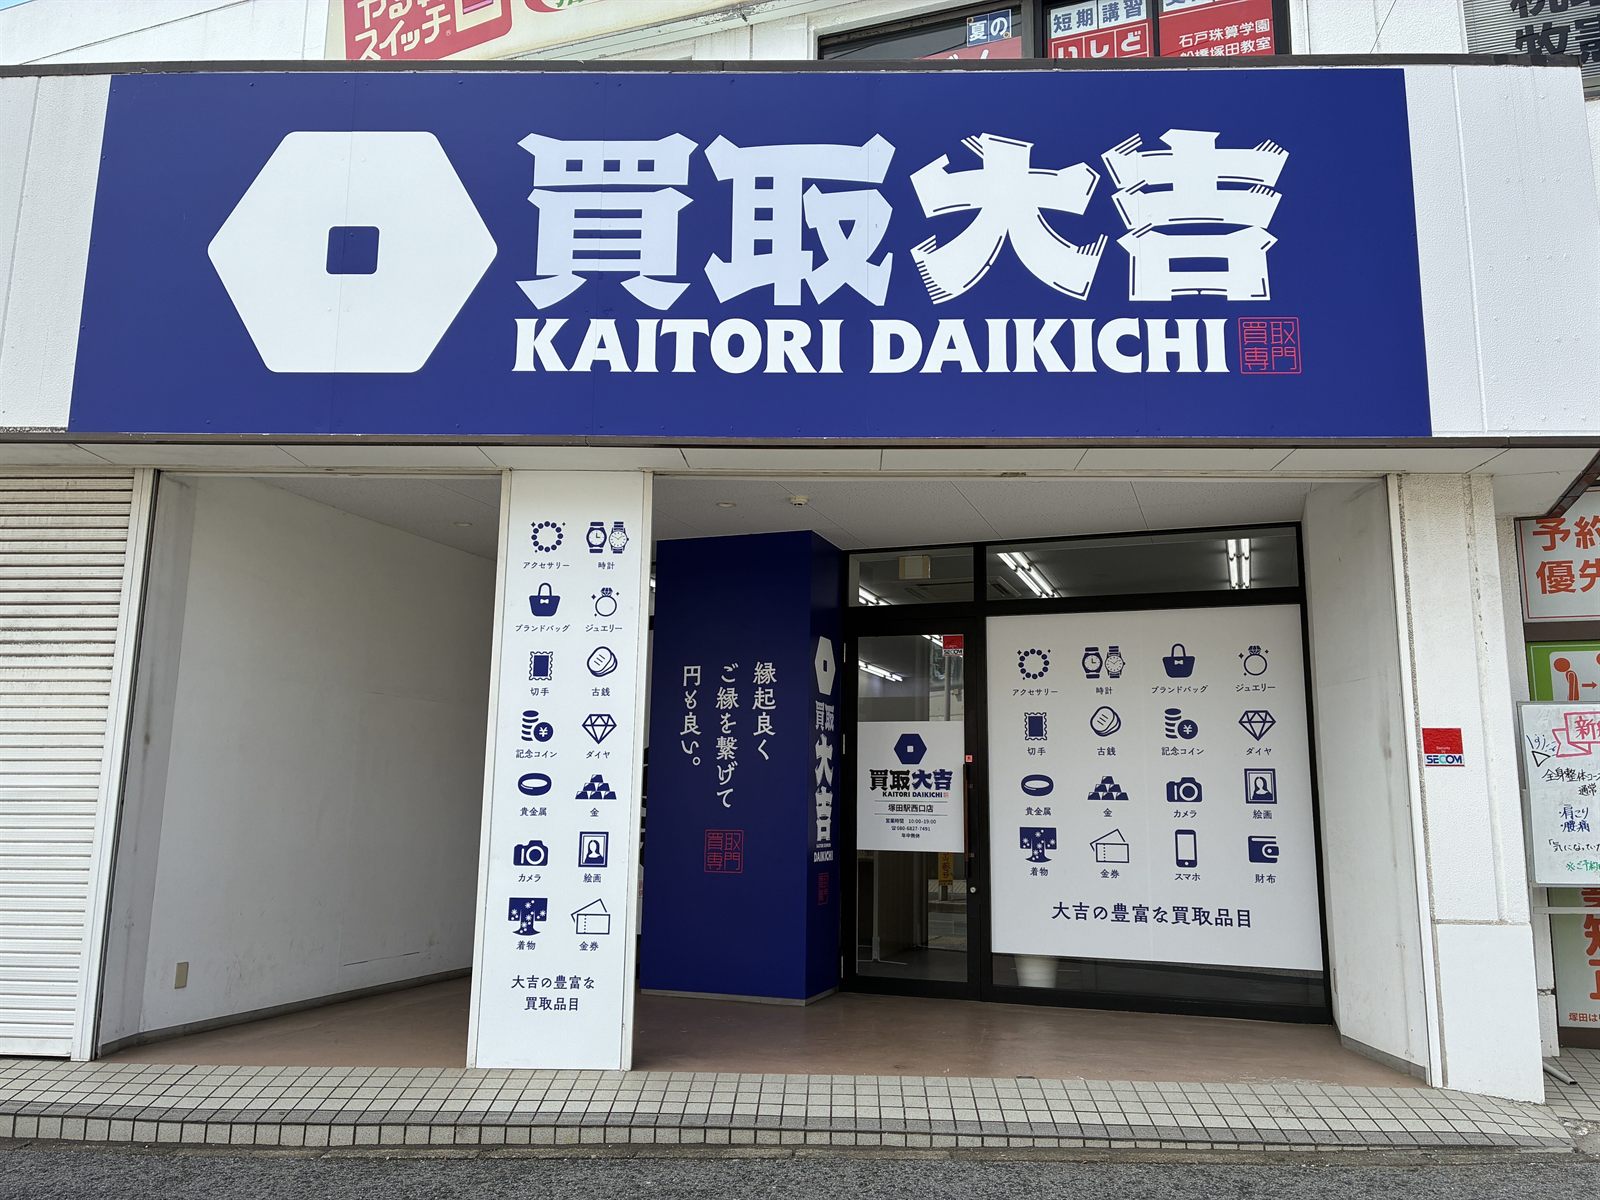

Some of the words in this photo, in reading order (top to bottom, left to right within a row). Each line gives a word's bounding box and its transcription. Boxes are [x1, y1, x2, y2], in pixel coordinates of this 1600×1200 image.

[357, 0, 442, 29] やる
[1053, 0, 1142, 33] 短期講習
[355, 4, 450, 59] スイッチ
[969, 17, 1008, 41] 夏の
[1178, 18, 1270, 48] 石戸珠算学園
[1057, 30, 1141, 58] いしど
[516, 129, 1289, 310] 買取大吉
[512, 319, 843, 373] KAITORI
[870, 318, 1230, 373] DAIKICHI
[522, 561, 571, 570] アクセサリー
[597, 560, 616, 571] 時計
[514, 623, 571, 633] ブランドバッグ
[584, 623, 623, 633] ジュエリー
[529, 686, 550, 697] 切手
[591, 686, 611, 697] 古銭
[1012, 687, 1059, 697] アクセサリー
[1095, 685, 1113, 696] 時計
[1151, 684, 1209, 696] ブランドバッグ
[1235, 682, 1277, 694] ジュエリー
[679, 665, 702, 767] 円も良い。
[752, 661, 778, 762] 縁起良く
[715, 662, 740, 809] ご縁を繋げて
[515, 748, 558, 760] 記念コイン
[585, 749, 611, 760] ダイヤ
[1026, 746, 1047, 757] 切手
[1096, 746, 1117, 757] 古銭
[1160, 745, 1205, 757] 記念コイン
[1245, 746, 1272, 757] ダイヤ
[1426, 755, 1462, 764] SECOM
[868, 768, 954, 791] 買取大吉
[912, 791, 943, 799] DAIKICHI
[519, 806, 548, 817] 貴金属
[589, 807, 600, 818] 金
[888, 803, 934, 813] 塚田駅西口店
[1024, 806, 1052, 817] 貴金属
[1102, 807, 1113, 818] 金
[1173, 808, 1198, 819] カメラ
[1252, 808, 1273, 820] 絵画
[517, 872, 542, 883] カメラ
[1029, 866, 1049, 877] 着物
[1099, 868, 1121, 879] 金券
[1174, 872, 1201, 882] スマホ
[582, 872, 602, 884] 絵画
[1254, 873, 1277, 885] 財布
[1050, 901, 1252, 929] 大吉の豊富な買取品目
[515, 939, 537, 951] 着物
[578, 940, 600, 952] 金券
[510, 974, 595, 990] 大吉の豊富な
[523, 996, 579, 1012] 買取品目
[1568, 1011, 1600, 1023] 塚田は
